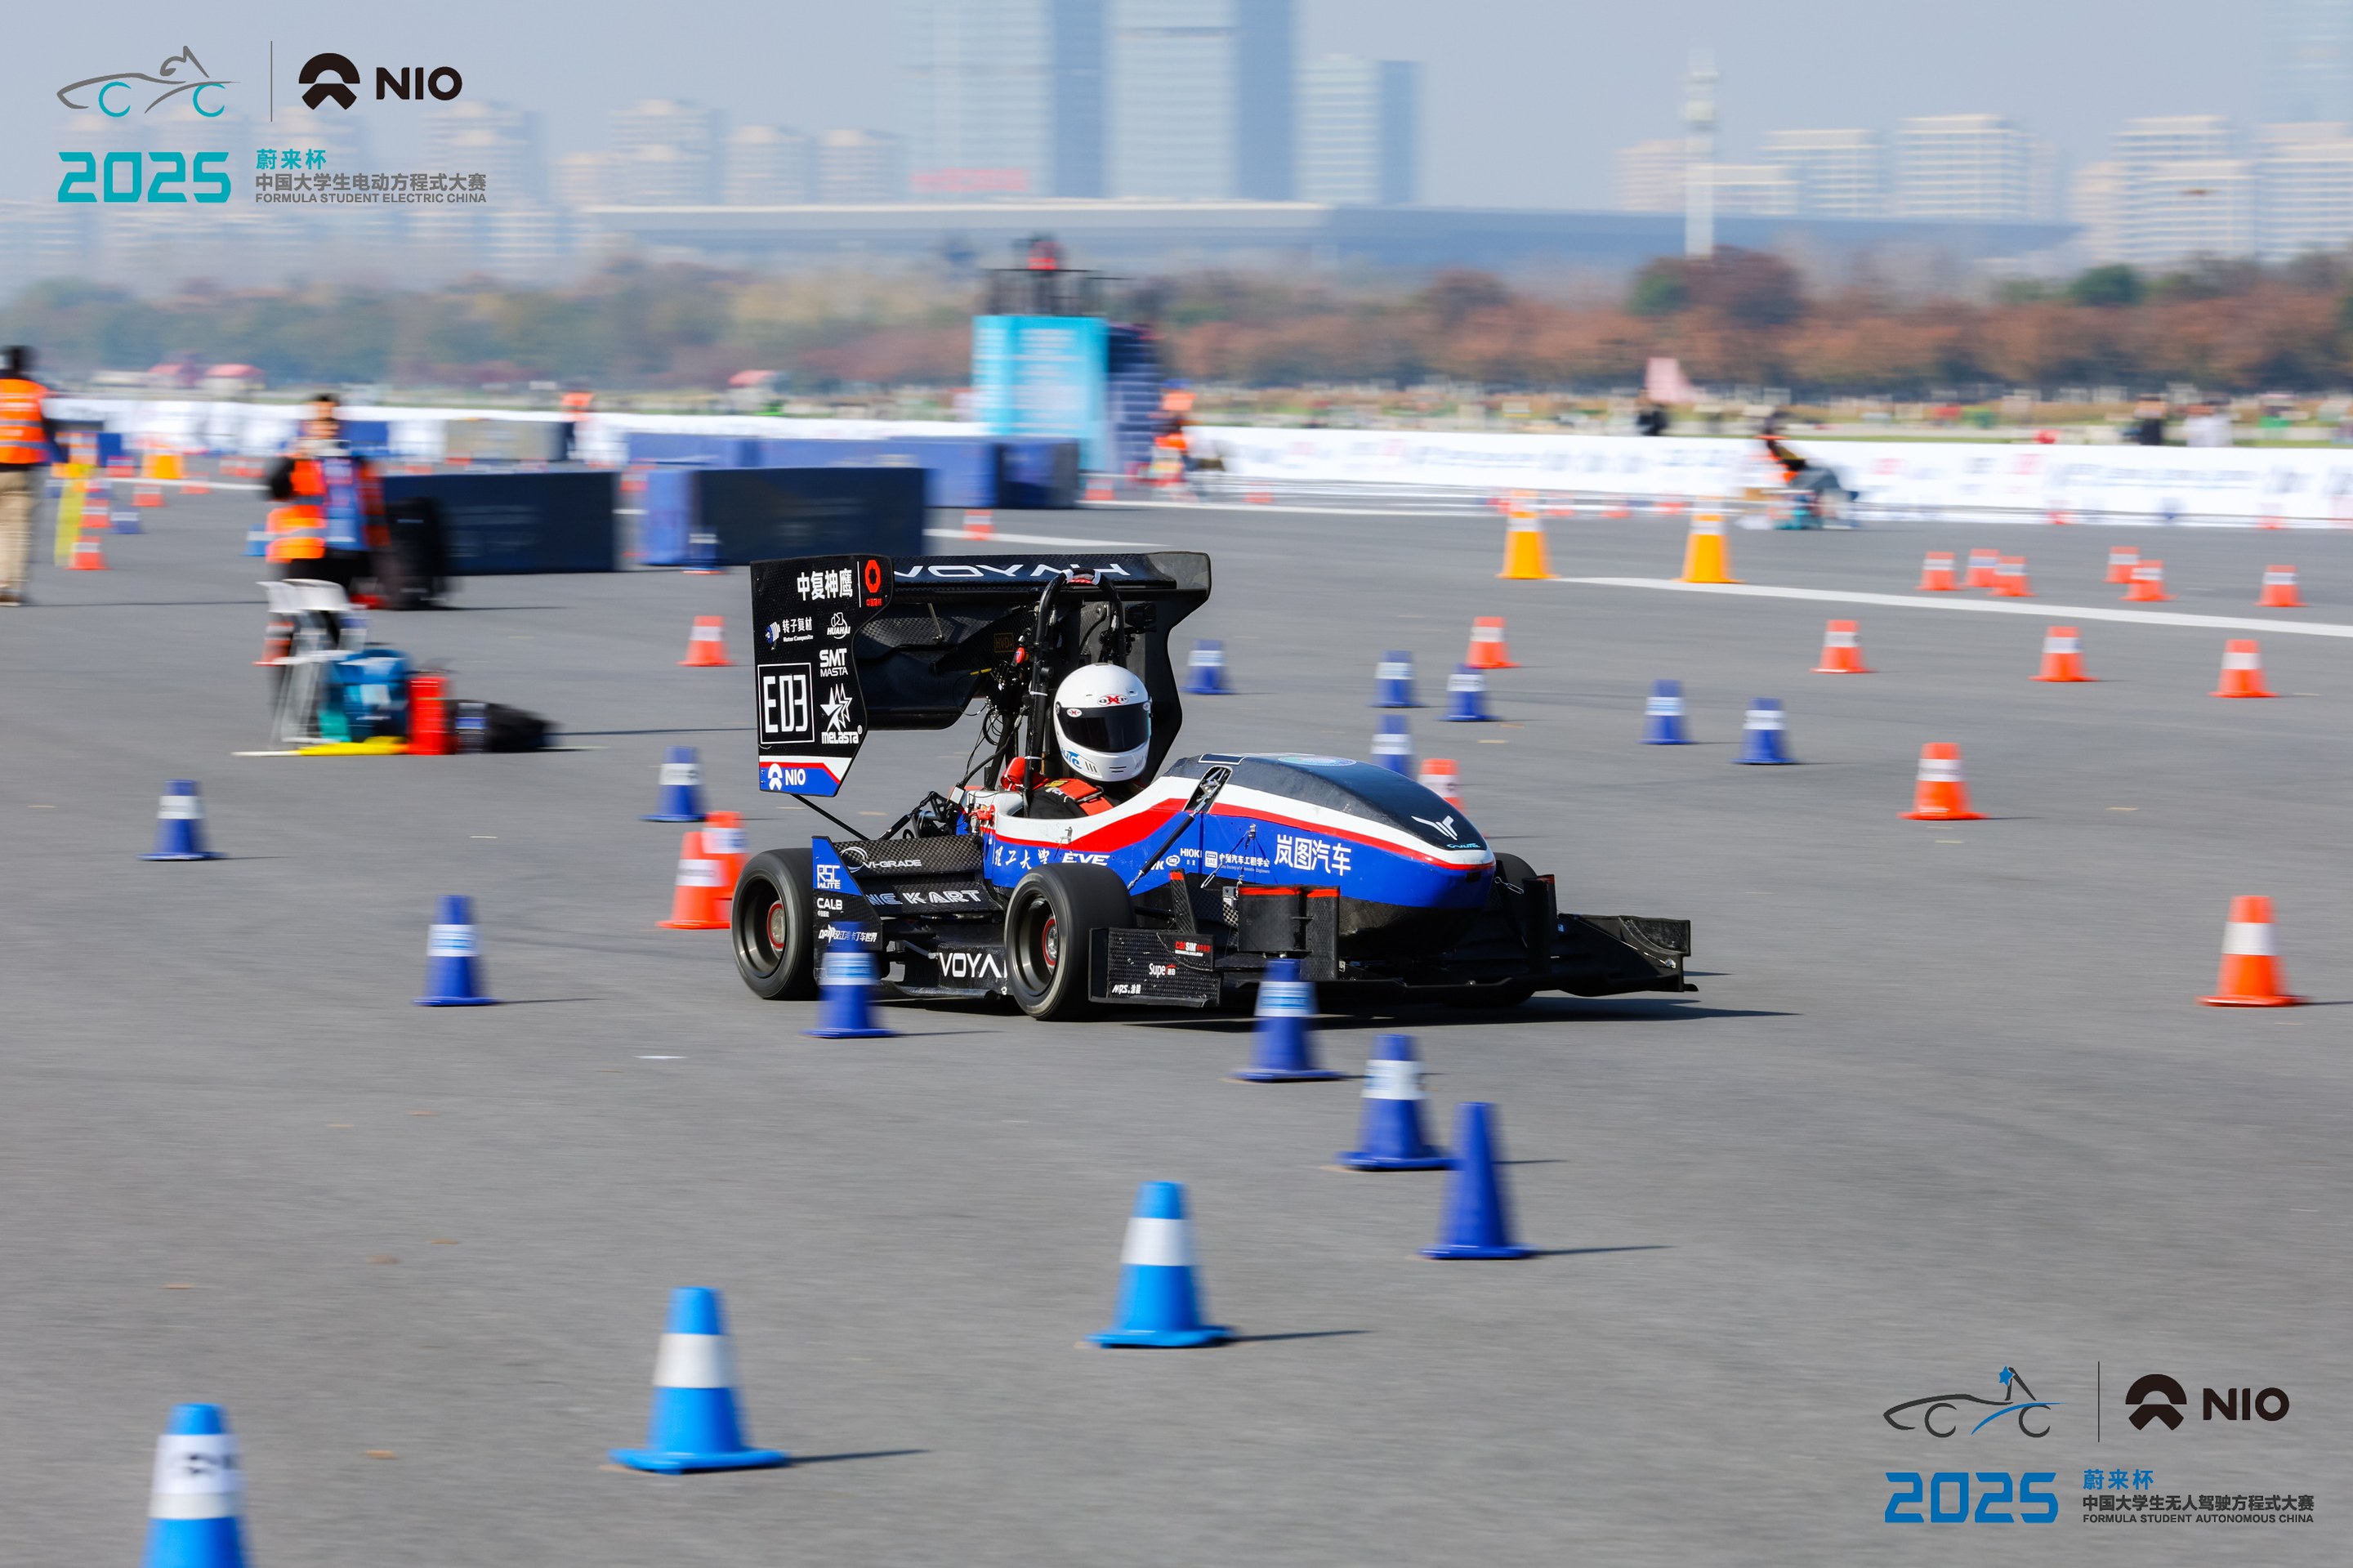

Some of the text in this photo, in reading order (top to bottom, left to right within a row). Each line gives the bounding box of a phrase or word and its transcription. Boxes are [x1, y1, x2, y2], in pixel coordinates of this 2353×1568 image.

[797, 568, 853, 601] 中复神鹰
[782, 616, 813, 634] 转子复材
[827, 626, 851, 636] HUAHAI
[819, 648, 847, 668] SMT
[819, 667, 849, 677] MASTA
[762, 674, 808, 734] E03
[785, 768, 806, 785] NIO
[1062, 852, 1110, 866] EVE
[1180, 847, 1203, 858] HIOKI
[1274, 833, 1352, 877] 岚图汽车
[863, 860, 922, 869] VI-GRADE
[817, 897, 843, 910] CALB
[902, 890, 981, 905] KART
[939, 953, 1008, 979] VOYA
